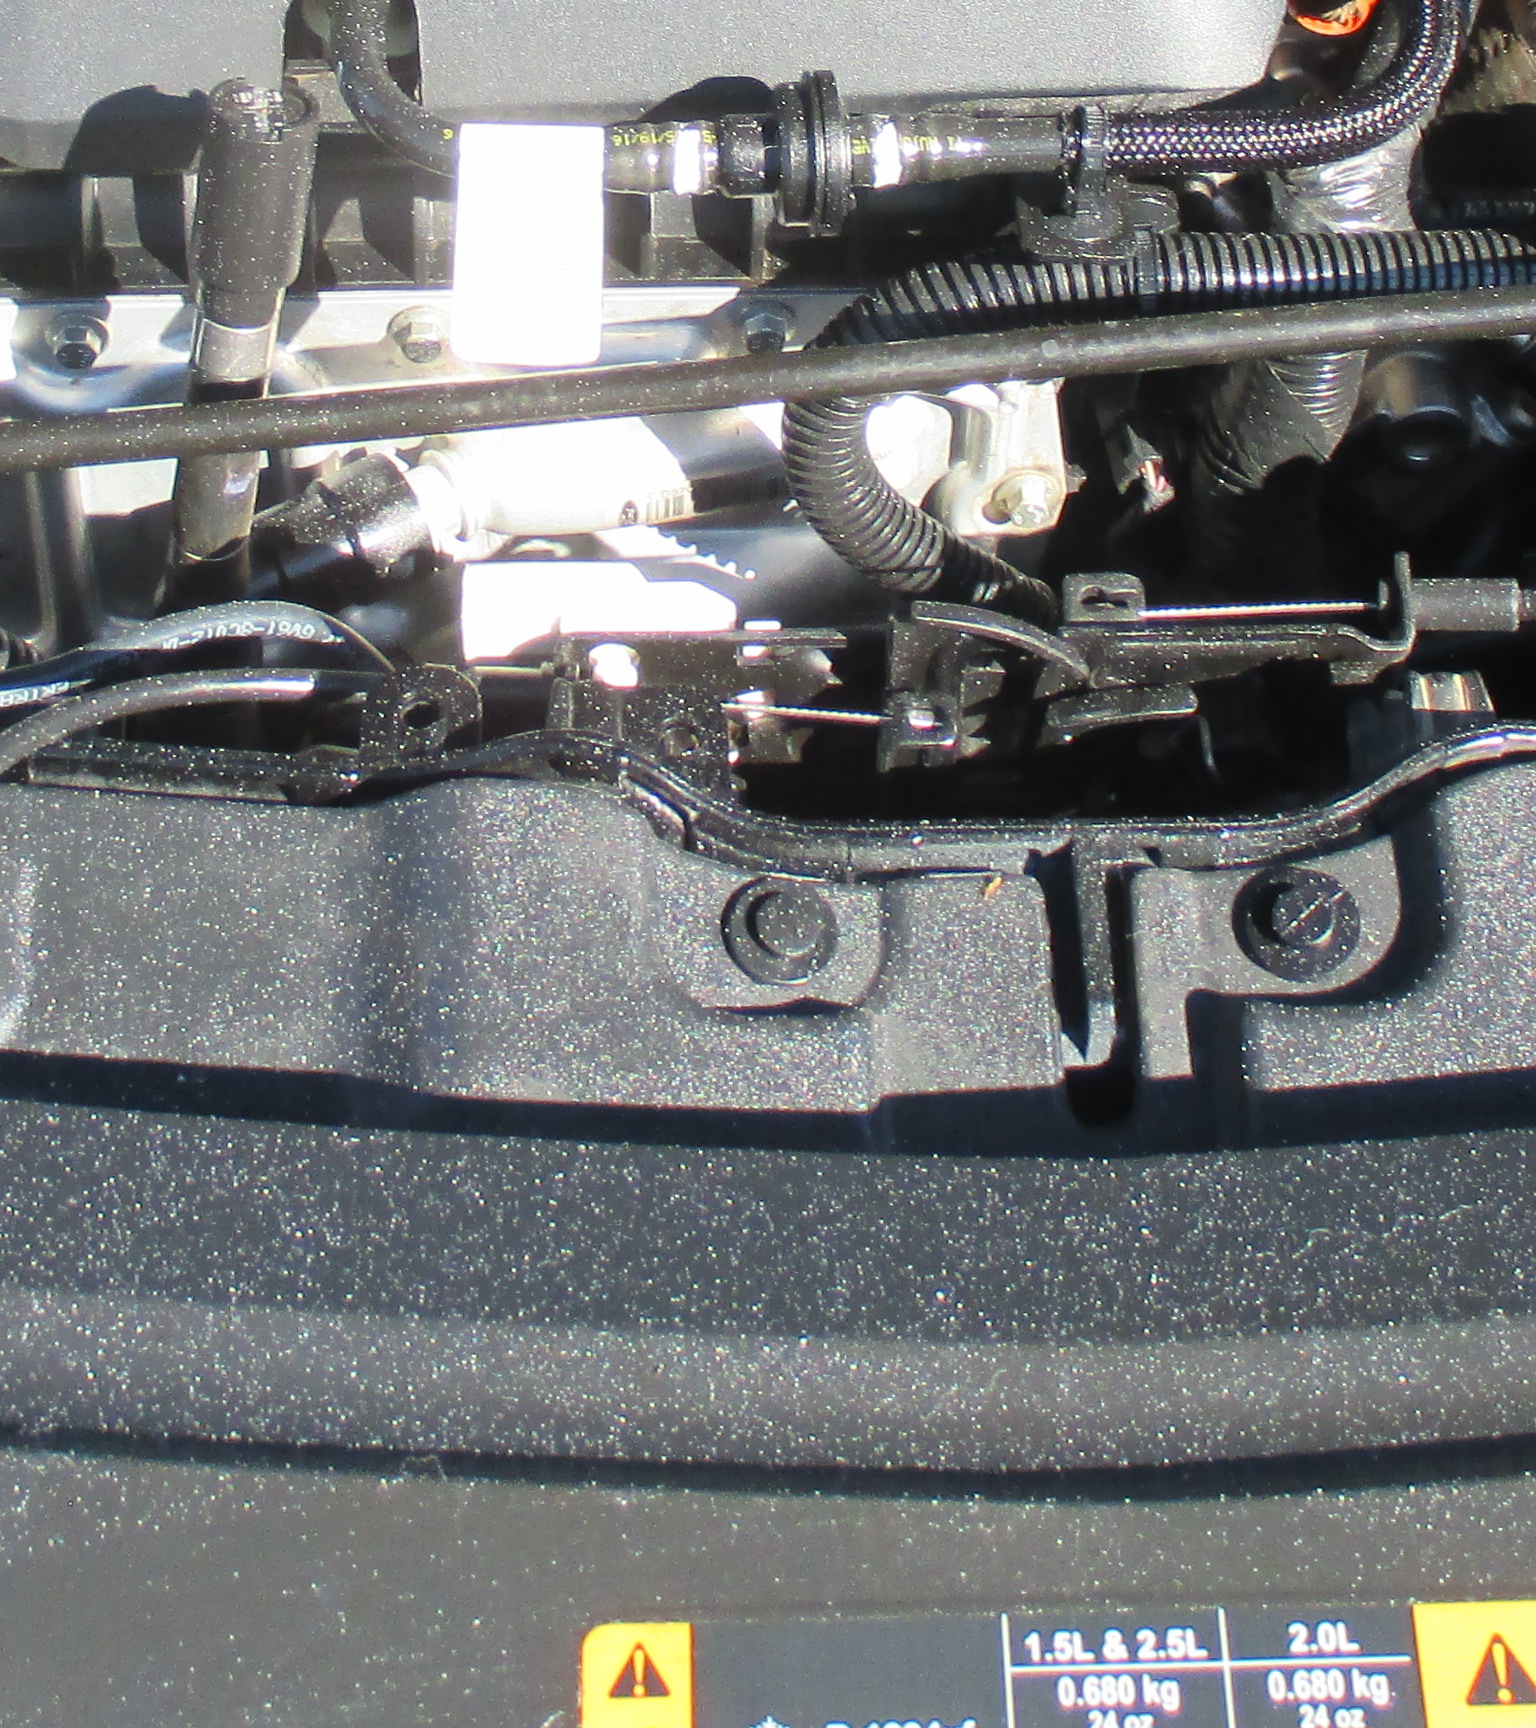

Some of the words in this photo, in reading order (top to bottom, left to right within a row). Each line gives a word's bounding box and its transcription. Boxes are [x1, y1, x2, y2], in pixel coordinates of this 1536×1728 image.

[1025, 1631, 1095, 1663] 1.5L
[1101, 1630, 1127, 1659] &
[1137, 1627, 1208, 1660] 2.5L
[1288, 1622, 1360, 1654] 2.0L
[1057, 1675, 1135, 1708] 0.680
[1142, 1674, 1182, 1710] kg
[1267, 1670, 1343, 1704] 0.680
[1351, 1669, 1389, 1709] kg
[1299, 1704, 1328, 1728] 24
[1335, 1711, 1365, 1728] oz
